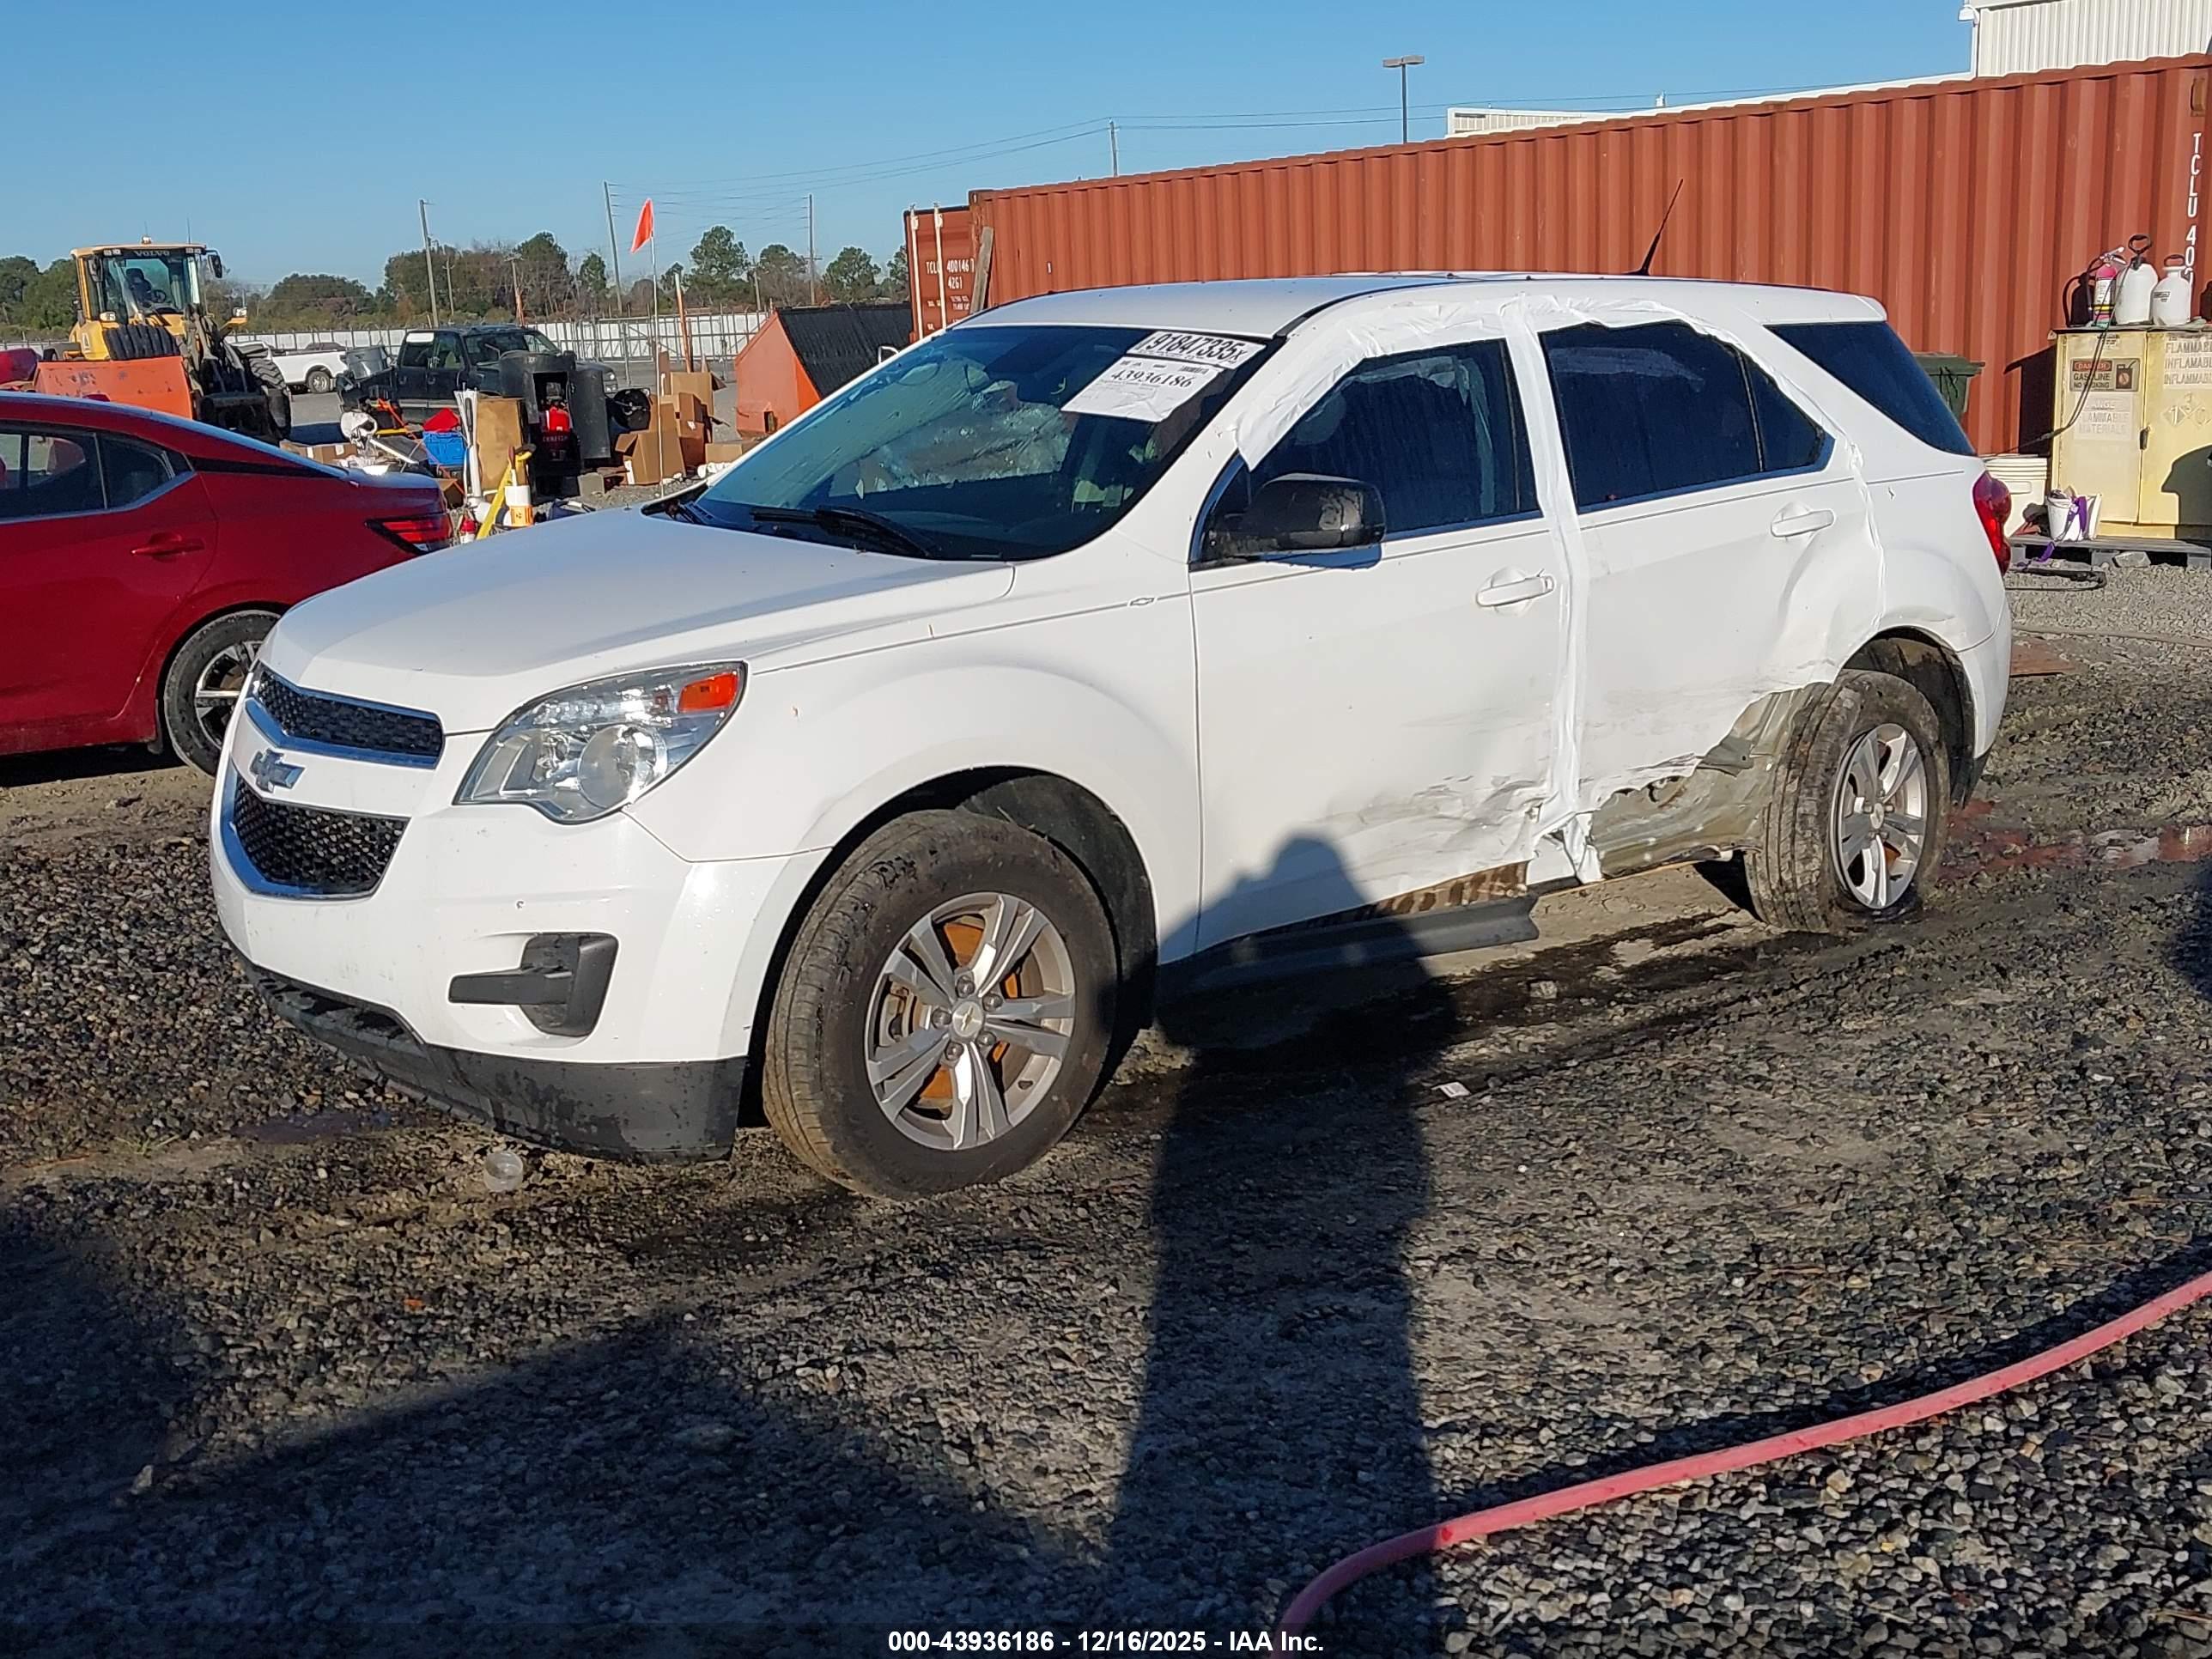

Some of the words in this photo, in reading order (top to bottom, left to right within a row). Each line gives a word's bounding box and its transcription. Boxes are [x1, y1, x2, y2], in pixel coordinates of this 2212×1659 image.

[2188, 133, 2202, 217] TCLU
[1111, 370, 1196, 387] 43936186
[2074, 373, 2111, 381] GASLINE
